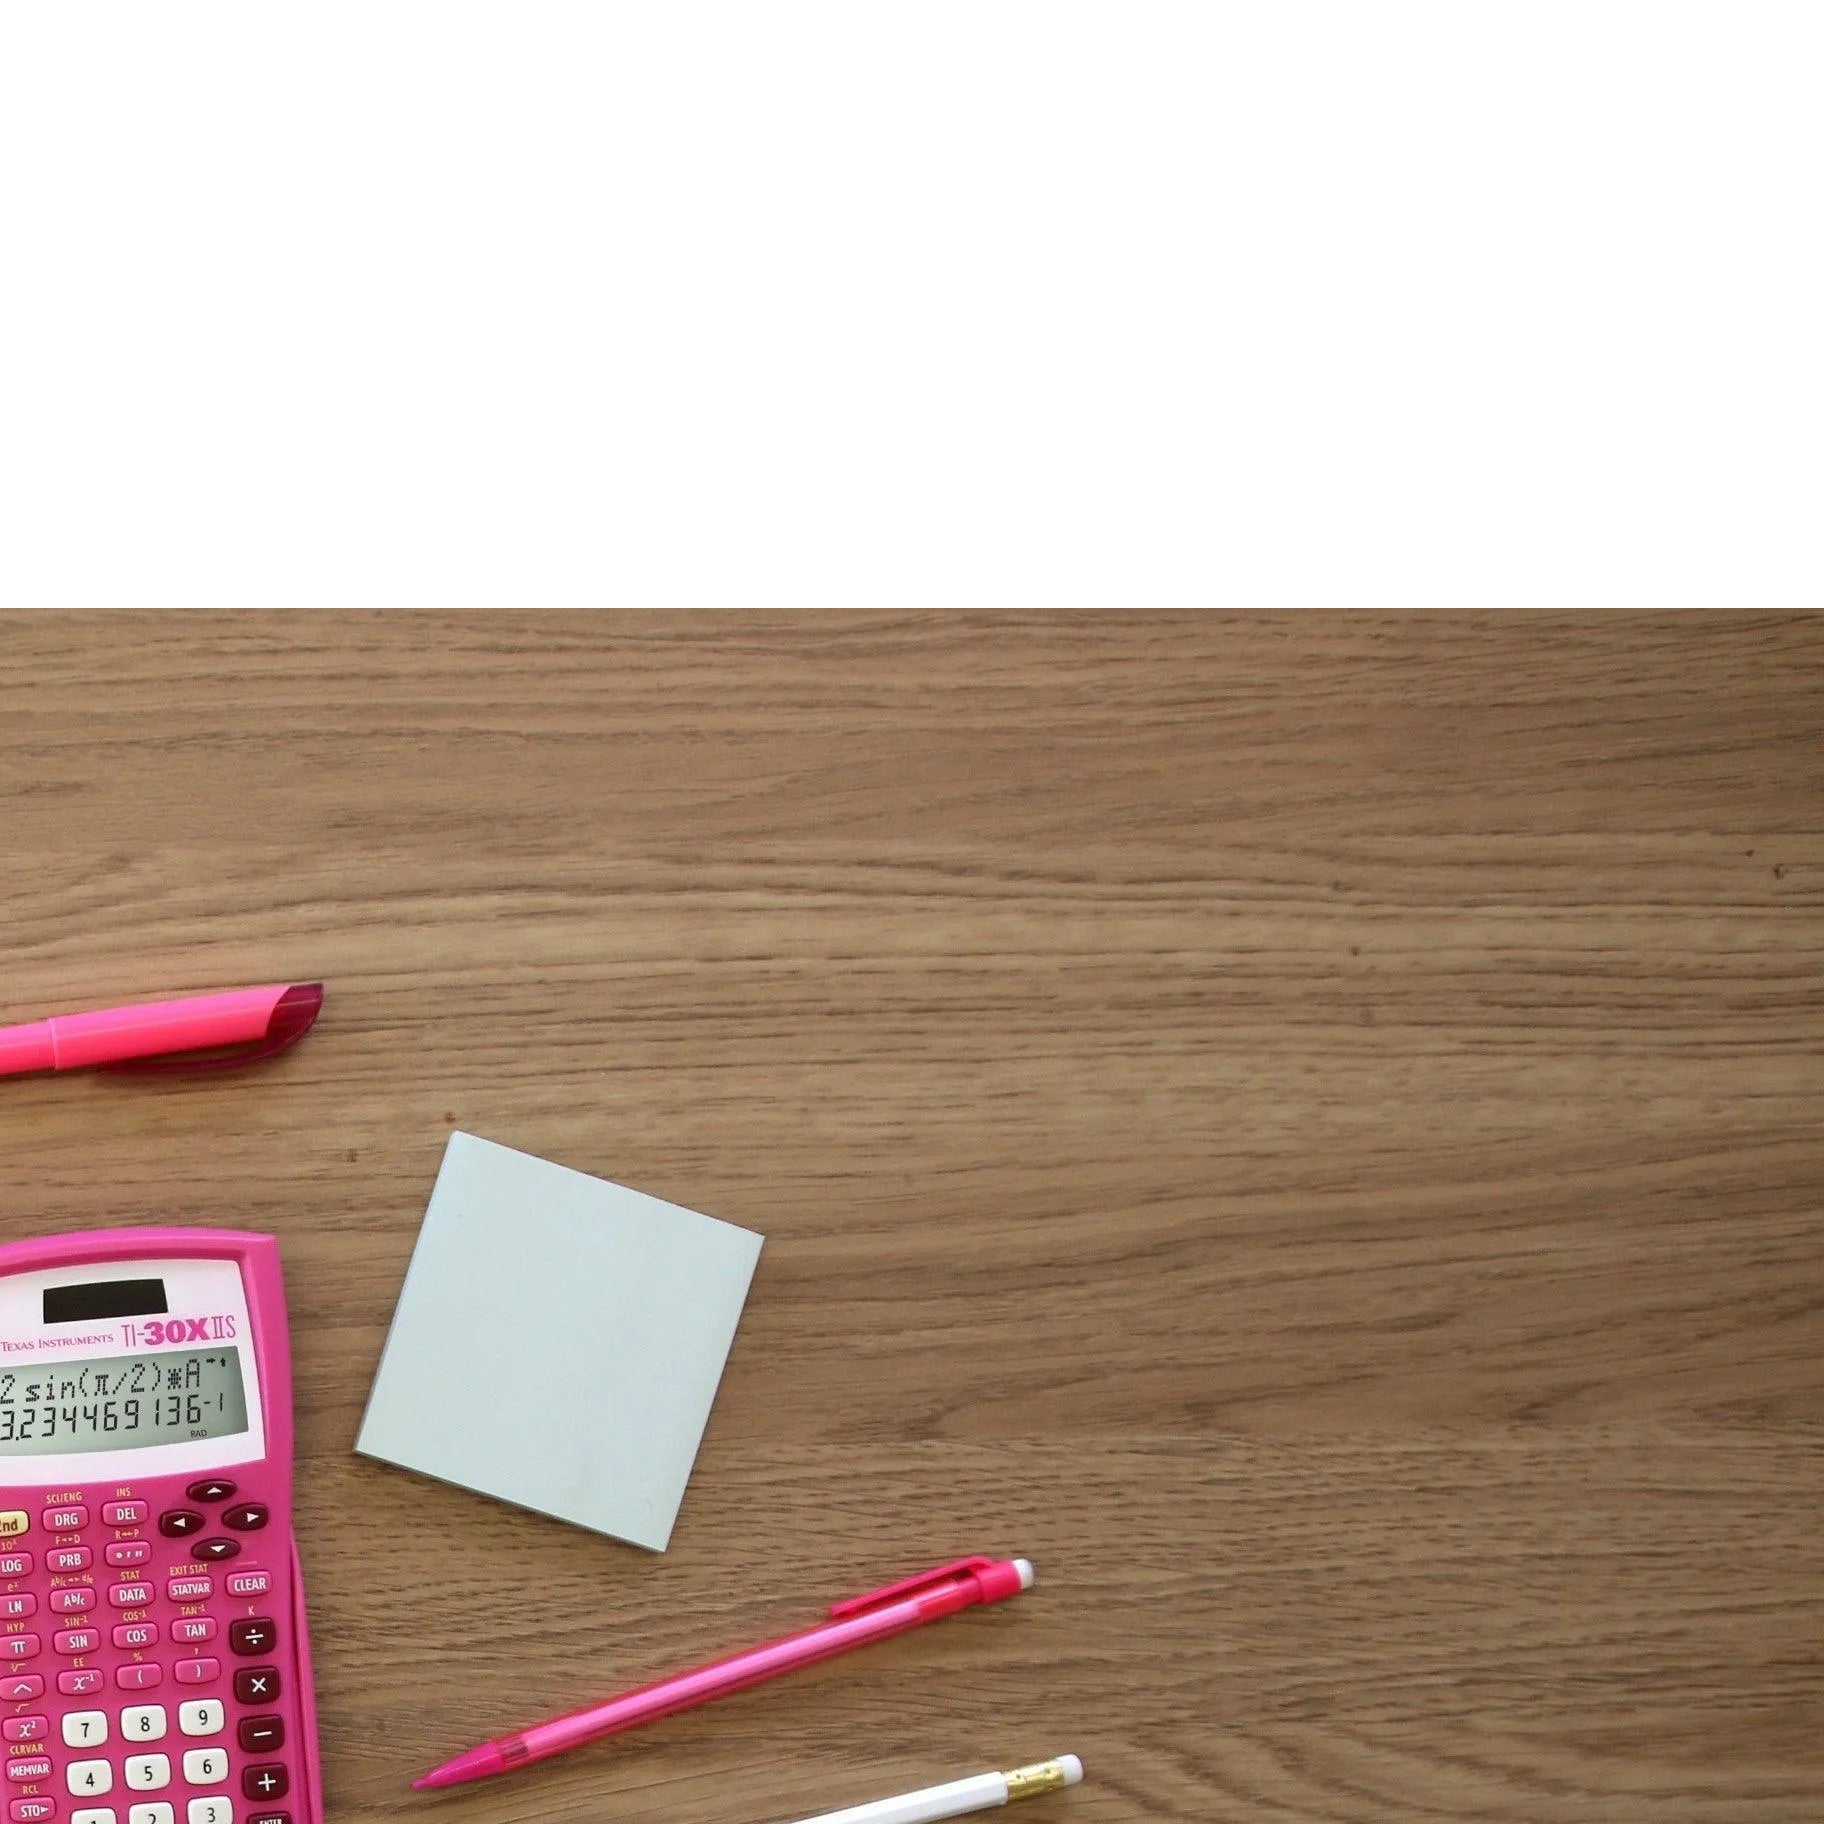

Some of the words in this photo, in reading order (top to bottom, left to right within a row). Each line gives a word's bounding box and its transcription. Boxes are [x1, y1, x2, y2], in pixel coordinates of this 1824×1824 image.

[0, 1341, 35, 1352] TEXAS
[38, 1333, 114, 1349] INSTRUMENTS
[190, 1429, 208, 1438] RAD
[46, 1492, 82, 1504] SCI/ENG
[116, 1486, 131, 1497] INS
[54, 1513, 78, 1527] DRG
[117, 1508, 137, 1520] DEL
[1, 1560, 22, 1573] LOG
[59, 1553, 82, 1567] PRB
[120, 1570, 140, 1581] STAT
[170, 1565, 187, 1576] EXIT
[189, 1563, 208, 1574] STAT
[172, 1582, 211, 1596] STATVAR
[234, 1577, 267, 1592] CLEAR
[119, 1587, 147, 1602] DATA
[8, 1600, 23, 1614] LN
[248, 1606, 255, 1616] K
[6, 1622, 25, 1632] HYP
[184, 1624, 206, 1637] TAN
[69, 1635, 88, 1649] SIN
[126, 1629, 147, 1643] COS
[73, 1658, 85, 1668] EE
[140, 1716, 150, 1732] 8
[198, 1709, 208, 1726] 9
[81, 1722, 90, 1738] 7
[9, 1743, 45, 1755] CLRVAR
[9, 1763, 50, 1777] MEMVAR
[144, 1765, 153, 1781] 5
[203, 1759, 212, 1774] 6
[85, 1772, 95, 1788] 4
[22, 1784, 39, 1795] RCL
[206, 1807, 216, 1823] 3
